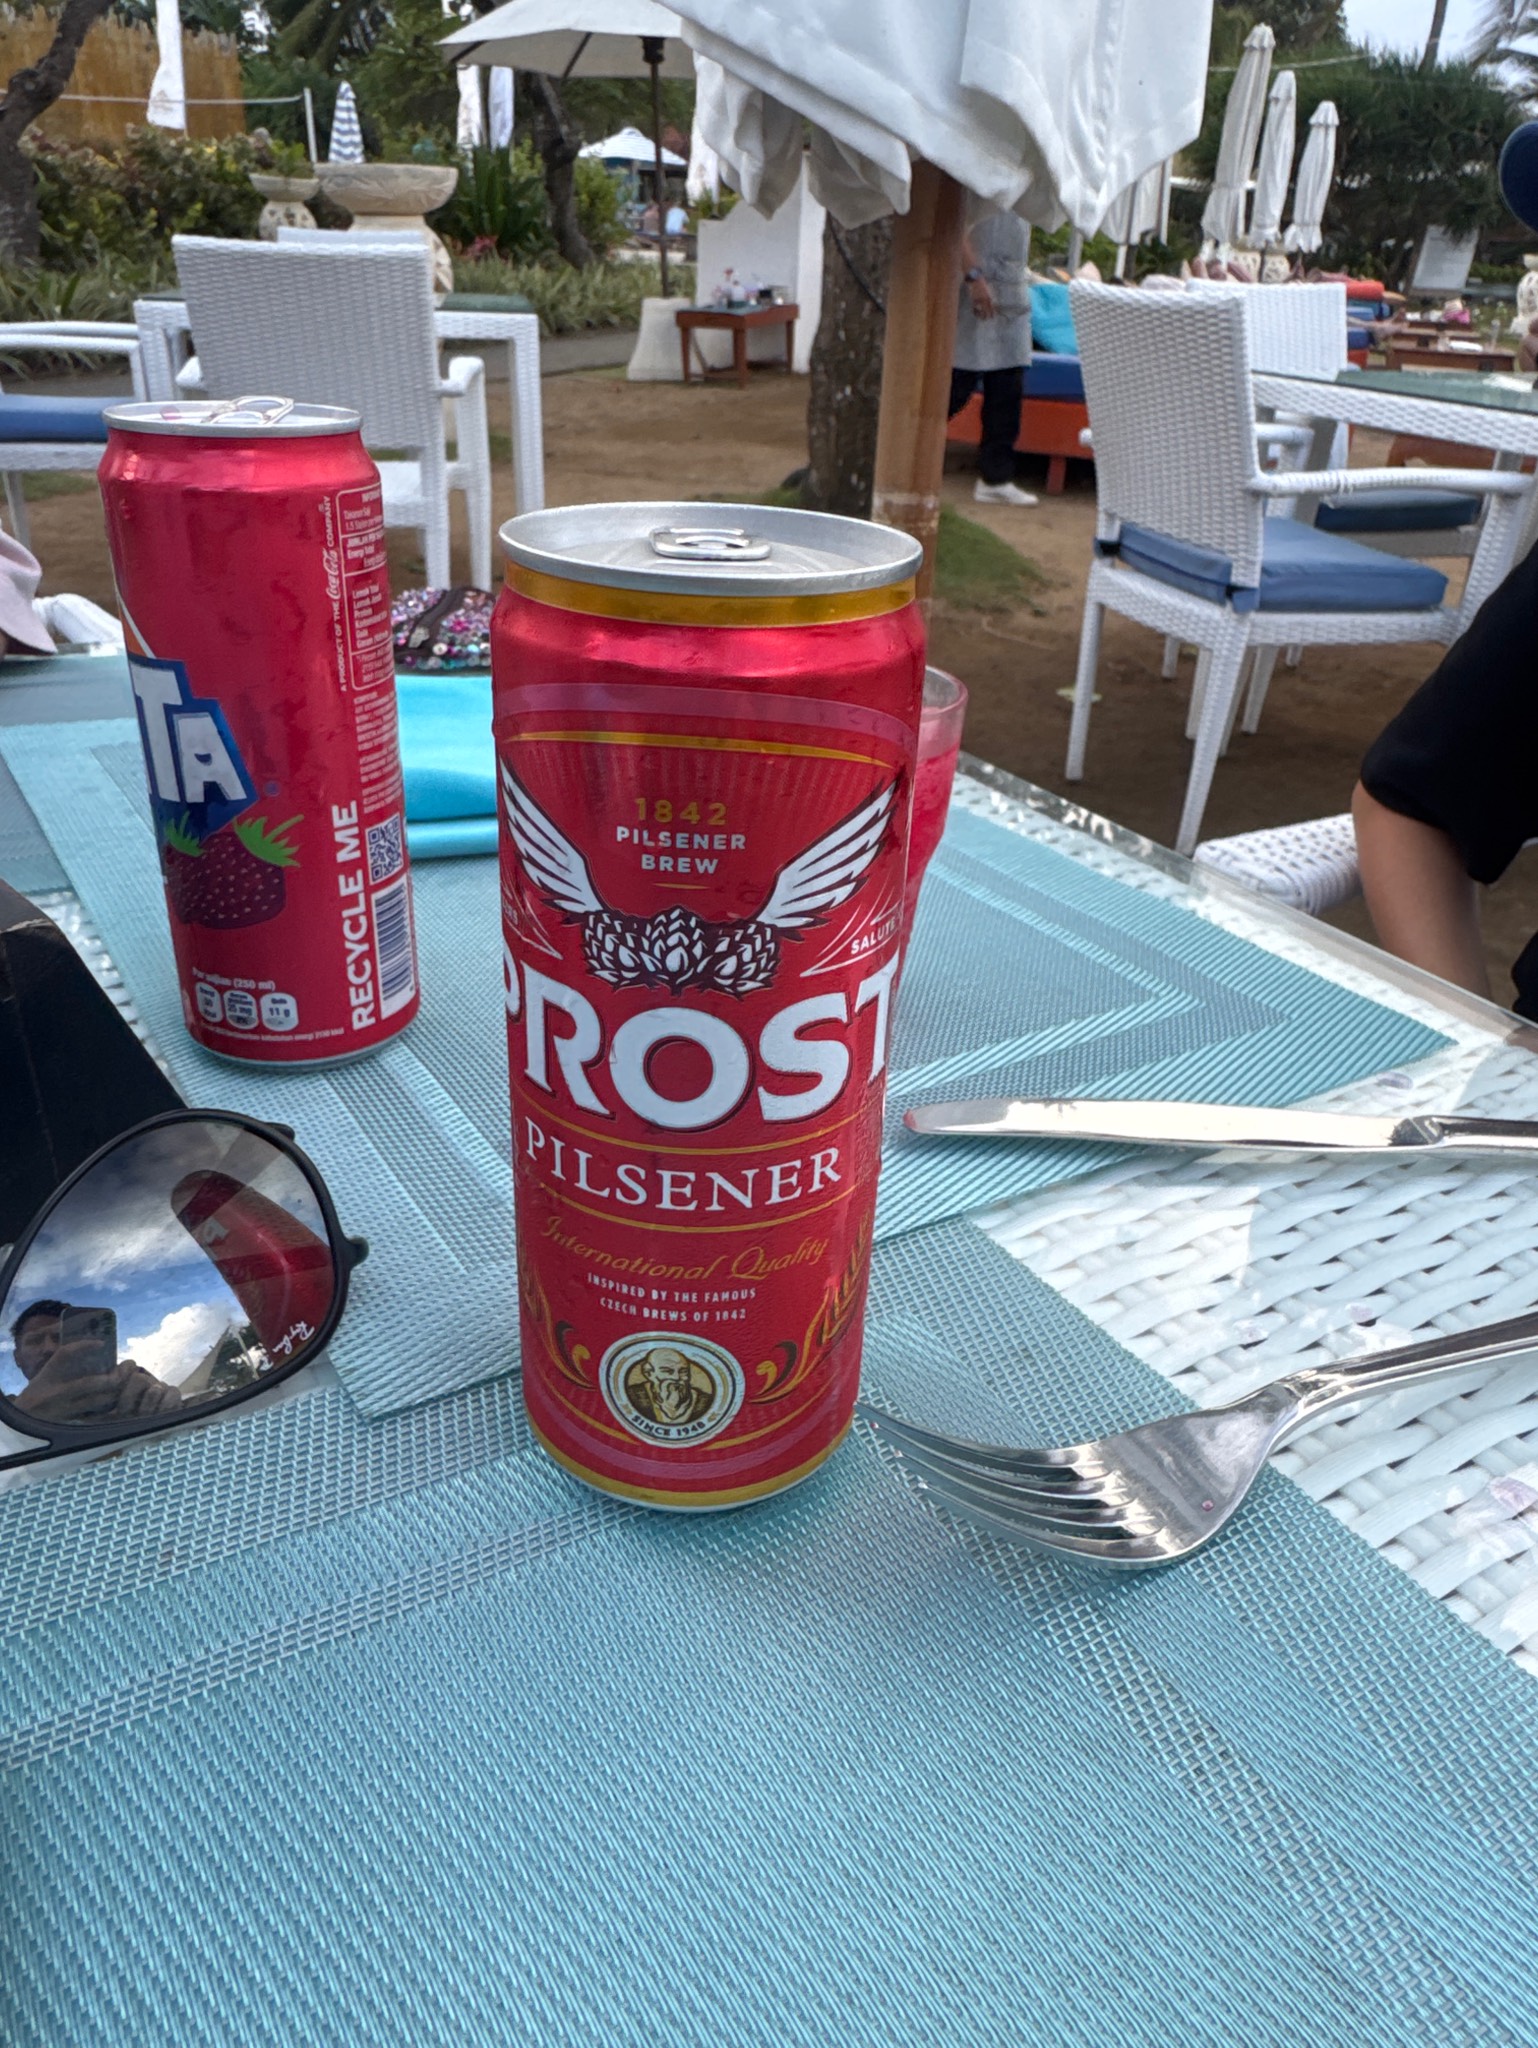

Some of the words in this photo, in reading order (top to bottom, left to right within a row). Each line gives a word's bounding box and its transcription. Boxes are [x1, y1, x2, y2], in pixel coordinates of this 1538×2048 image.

[323, 495, 335, 548] COMPANY
[332, 601, 341, 621] THE
[334, 623, 342, 637] OF
[335, 638, 347, 683] PRODUCT
[635, 797, 727, 825] 1842
[331, 800, 362, 863] ME
[616, 825, 746, 850] PILSENER
[641, 853, 719, 874] BREW
[338, 869, 376, 1031] RECYCLE
[525, 1115, 842, 1212] PILSENER
[540, 1215, 727, 1281] International
[730, 1236, 830, 1281] Quality
[587, 1272, 646, 1298] INSPIRED
[651, 1289, 667, 1301] BY
[674, 1291, 698, 1303] THE
[704, 1288, 757, 1303] FAMOUS
[600, 1297, 637, 1315] CZECH
[642, 1306, 687, 1322] BREWS
[693, 1311, 709, 1322] OF
[715, 1308, 746, 1322] 1842
[631, 1414, 671, 1437] SINCE
[676, 1421, 706, 1437] 1948
